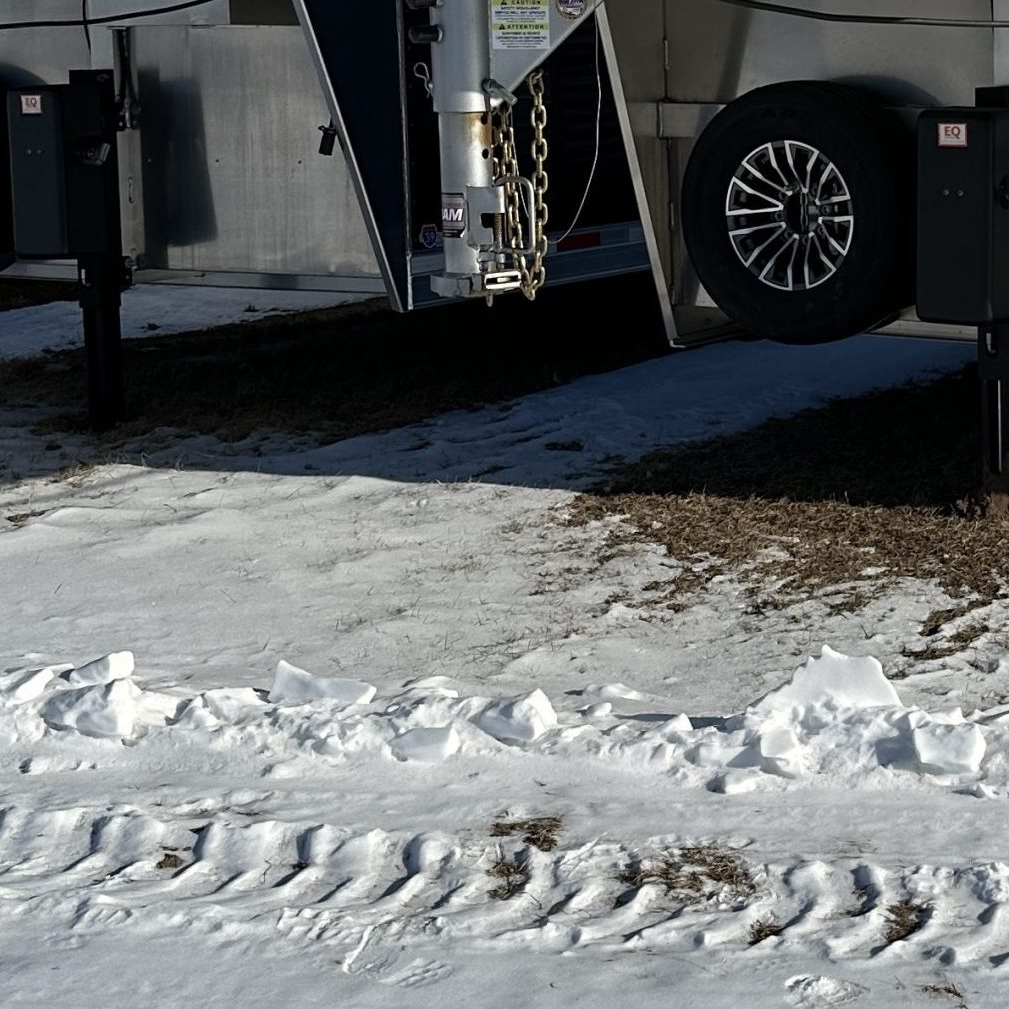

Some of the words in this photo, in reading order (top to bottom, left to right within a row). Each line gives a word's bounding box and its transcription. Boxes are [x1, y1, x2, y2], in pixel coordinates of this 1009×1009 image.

[25, 97, 37, 108] EQ
[944, 126, 960, 139] EQ
[442, 208, 463, 221] AM
